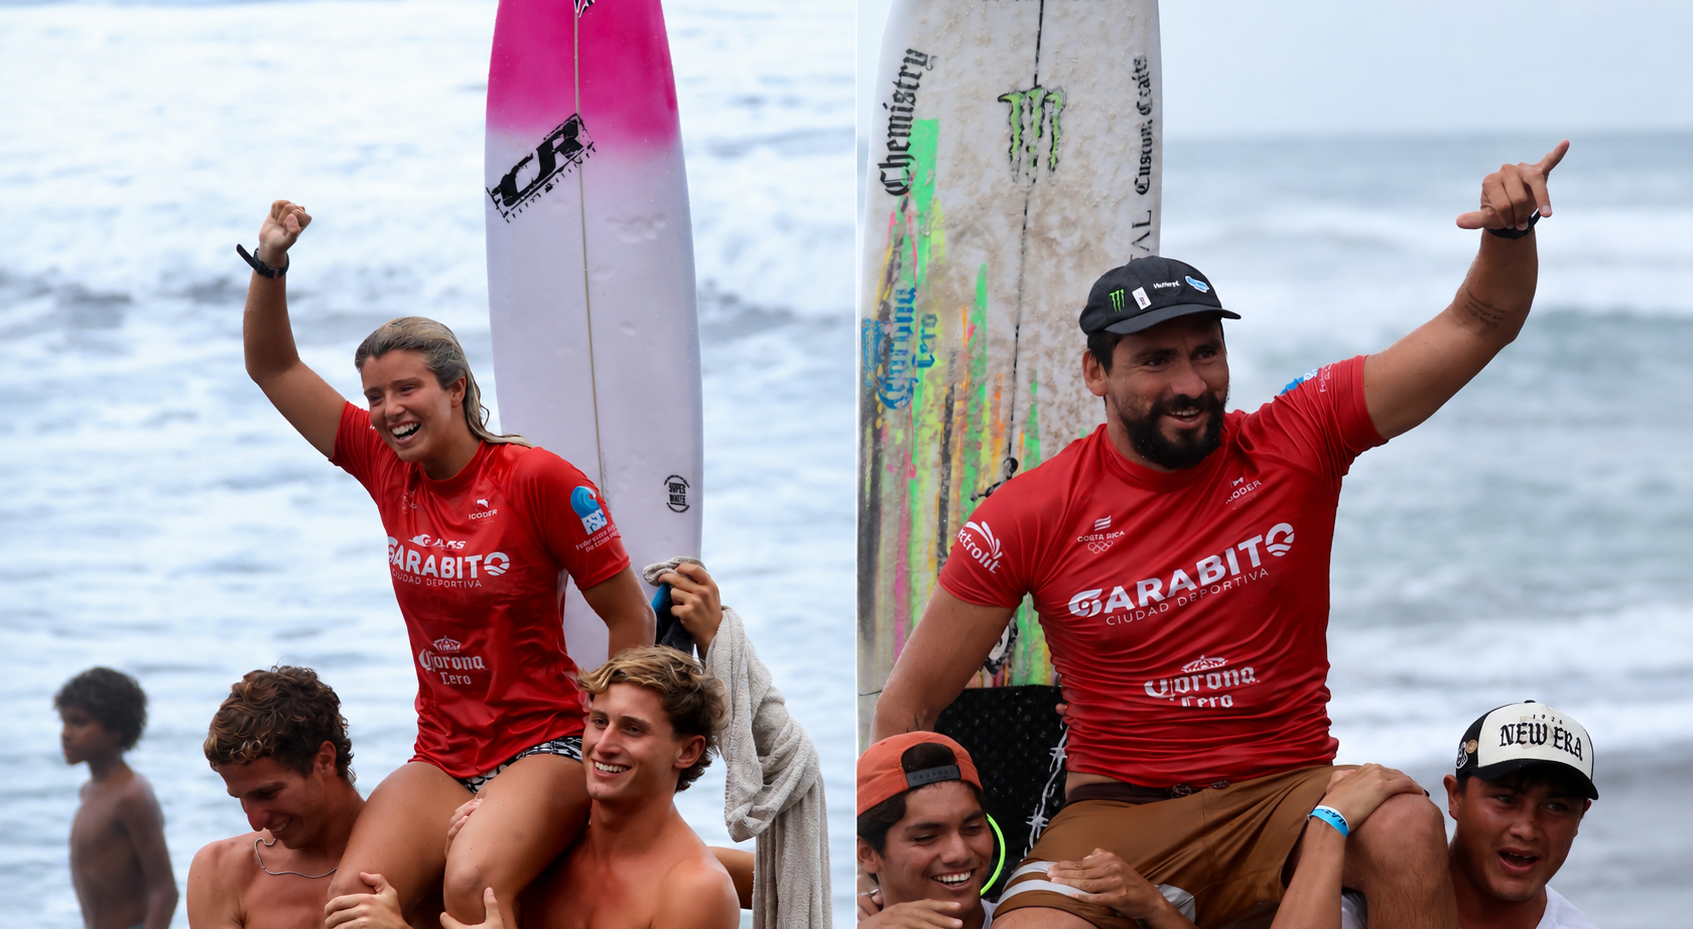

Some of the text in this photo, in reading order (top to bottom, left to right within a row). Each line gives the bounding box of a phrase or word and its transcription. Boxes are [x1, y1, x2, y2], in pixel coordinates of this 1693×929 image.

[877, 48, 938, 196] Chemistry
[468, 509, 498, 520] ICODER
[1077, 533, 1105, 542] COSTA
[392, 568, 483, 589] CIUDAD DEPORTIVA
[1068, 522, 1295, 618] GARABITO
[1106, 568, 1269, 626] CIUDAD DEPORTIVA
[418, 648, 486, 672] Corona
[1144, 666, 1258, 701] Corona
[1499, 722, 1583, 761] NEW ERA
